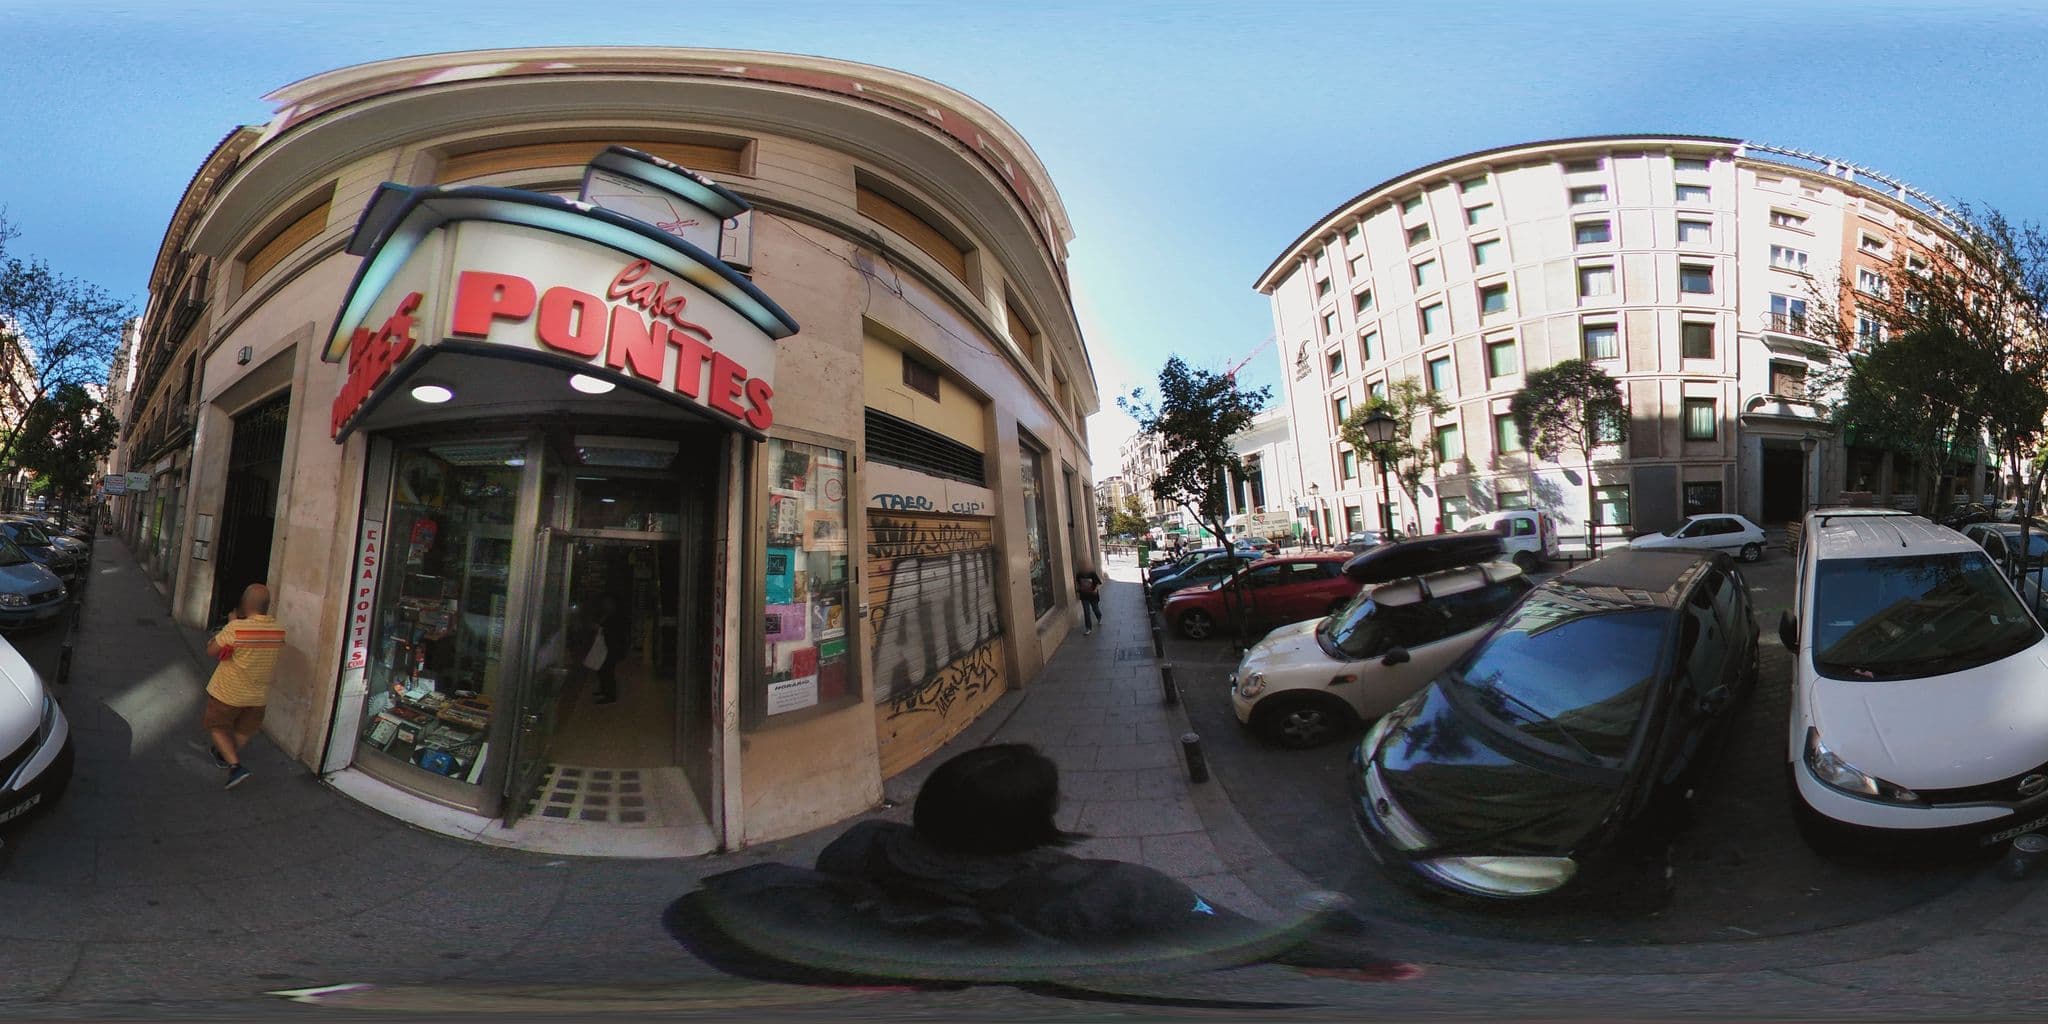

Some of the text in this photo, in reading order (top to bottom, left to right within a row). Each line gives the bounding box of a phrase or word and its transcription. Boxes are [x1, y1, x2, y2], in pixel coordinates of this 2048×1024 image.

[452, 270, 774, 431] PONTES
[608, 259, 713, 340] Casa
[351, 530, 377, 661] CASA PONTES
